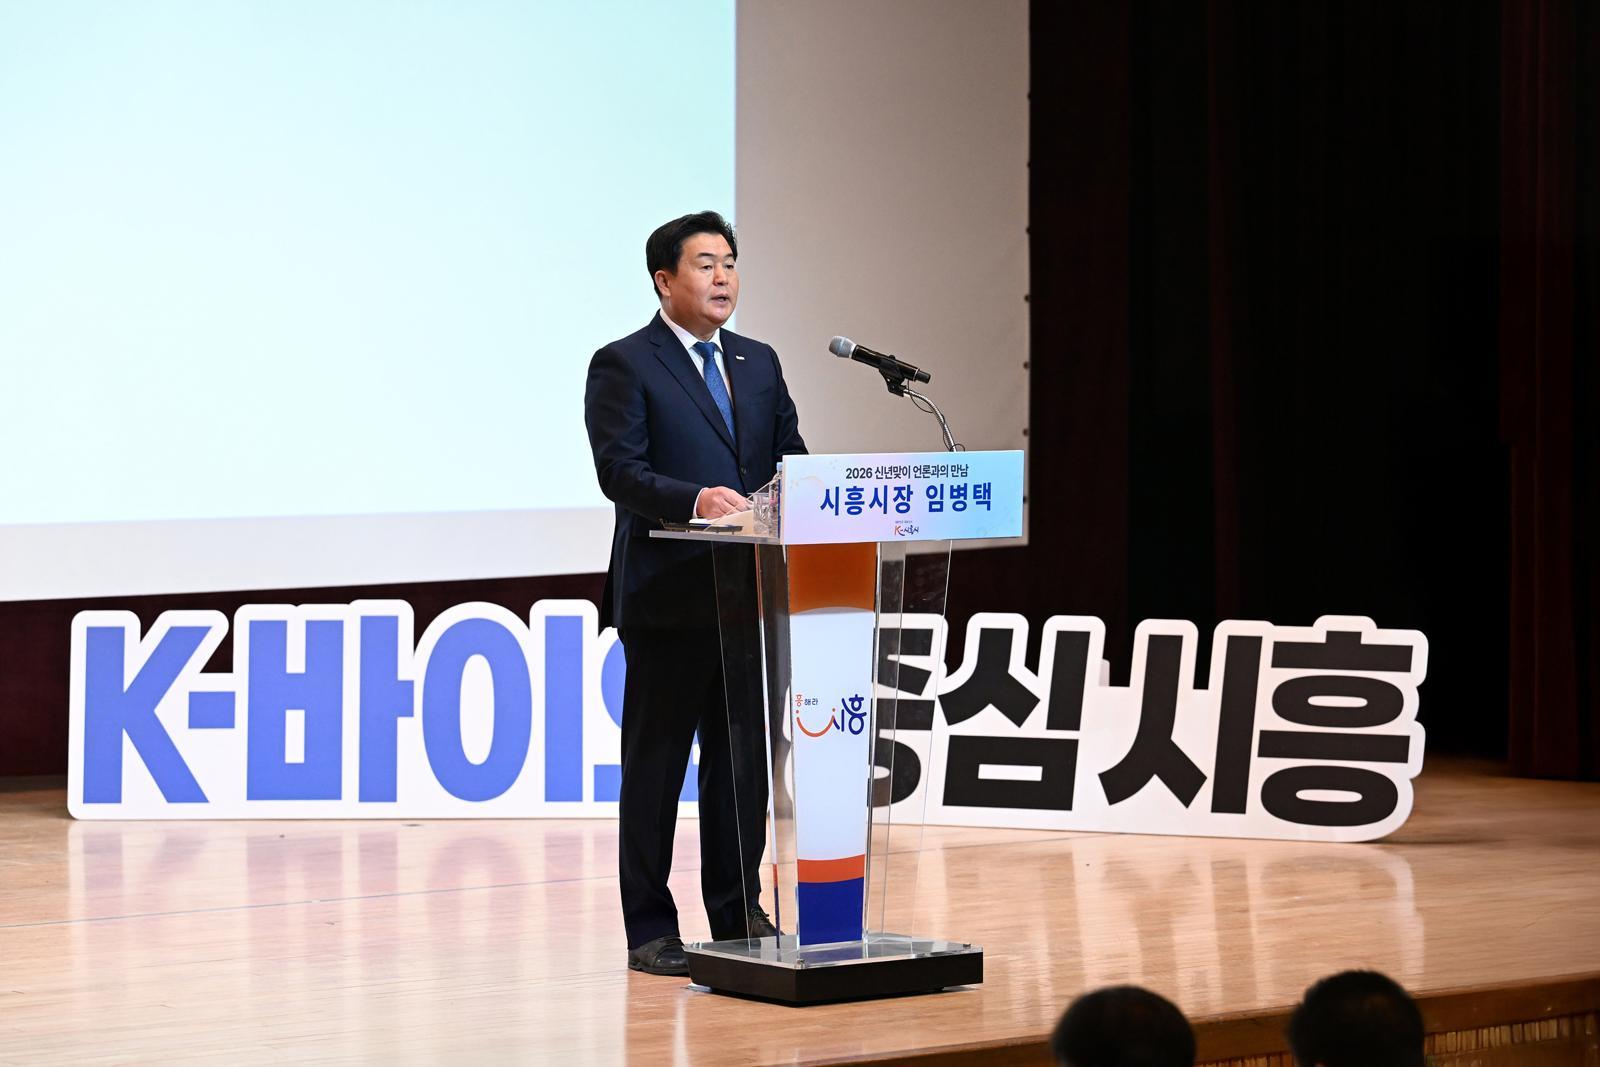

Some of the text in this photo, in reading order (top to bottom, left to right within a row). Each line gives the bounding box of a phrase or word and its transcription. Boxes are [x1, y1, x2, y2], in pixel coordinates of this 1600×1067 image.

[845, 463, 969, 480] 2026 신년맞이 언론과의 만남
[820, 482, 992, 516] 시흥시장 임병택
[1098, 630, 1414, 828] 시흥
